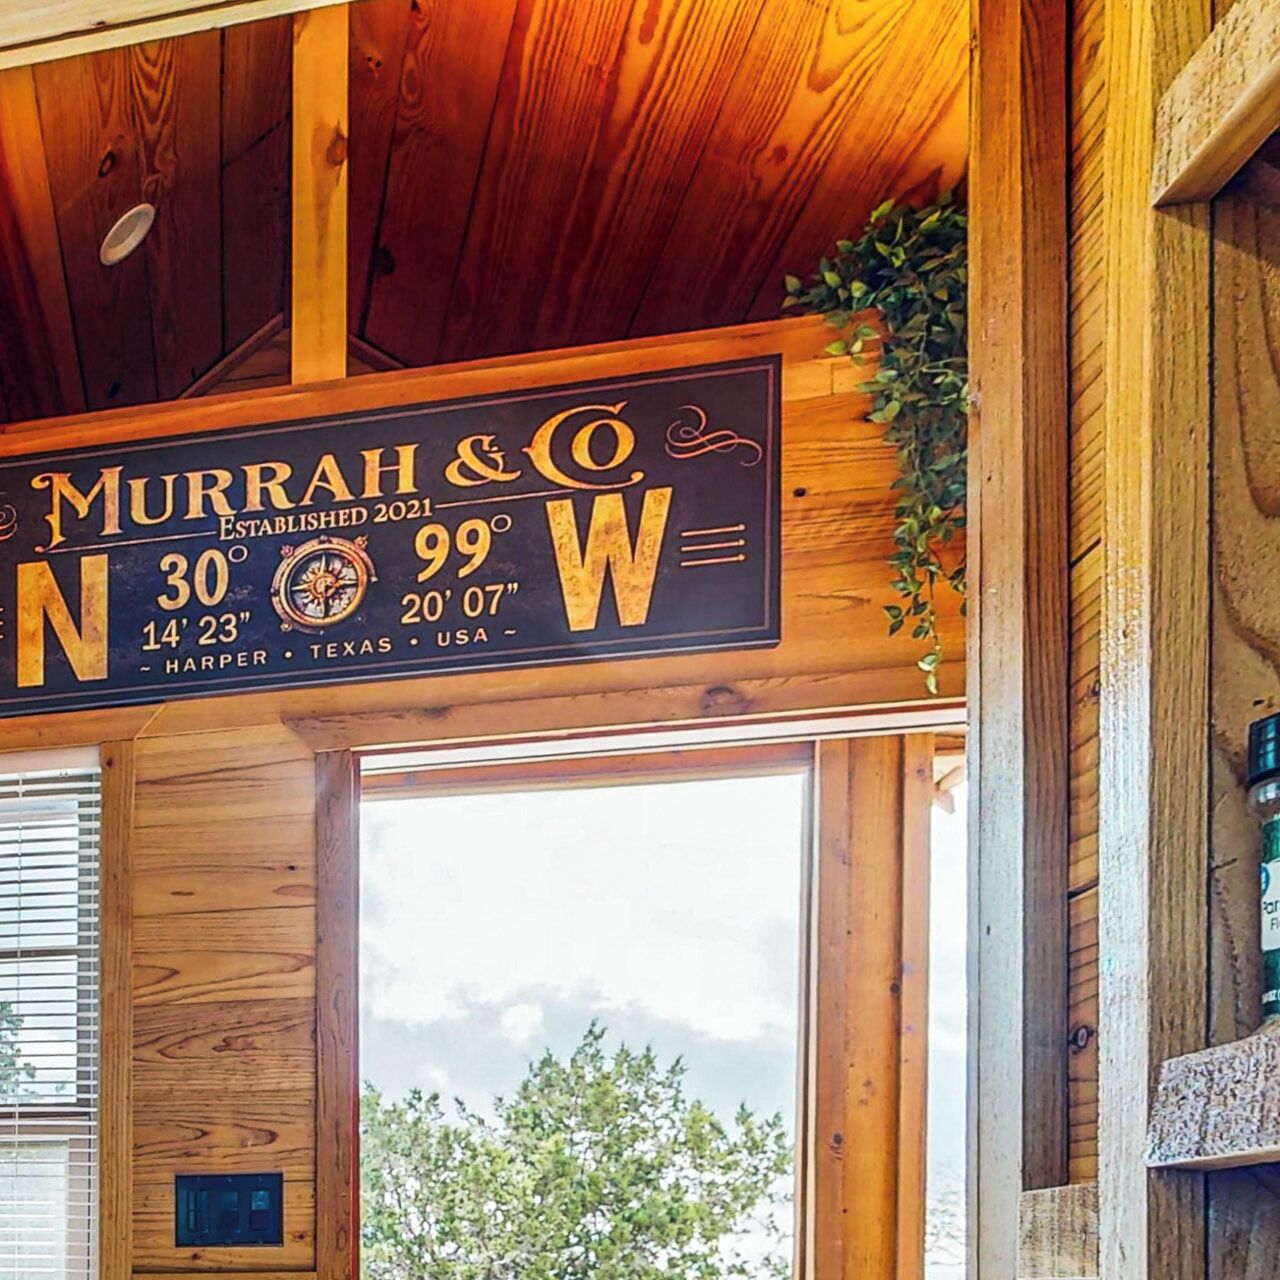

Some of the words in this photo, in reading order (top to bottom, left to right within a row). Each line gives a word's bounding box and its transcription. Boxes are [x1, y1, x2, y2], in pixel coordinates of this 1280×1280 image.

[444, 435, 522, 488] &
[373, 498, 433, 523] 2021
[545, 487, 673, 632] W
[17, 554, 109, 688] N
[165, 650, 268, 675] HARPER
[310, 637, 392, 659] TEXAS
[437, 627, 488, 647] USA
